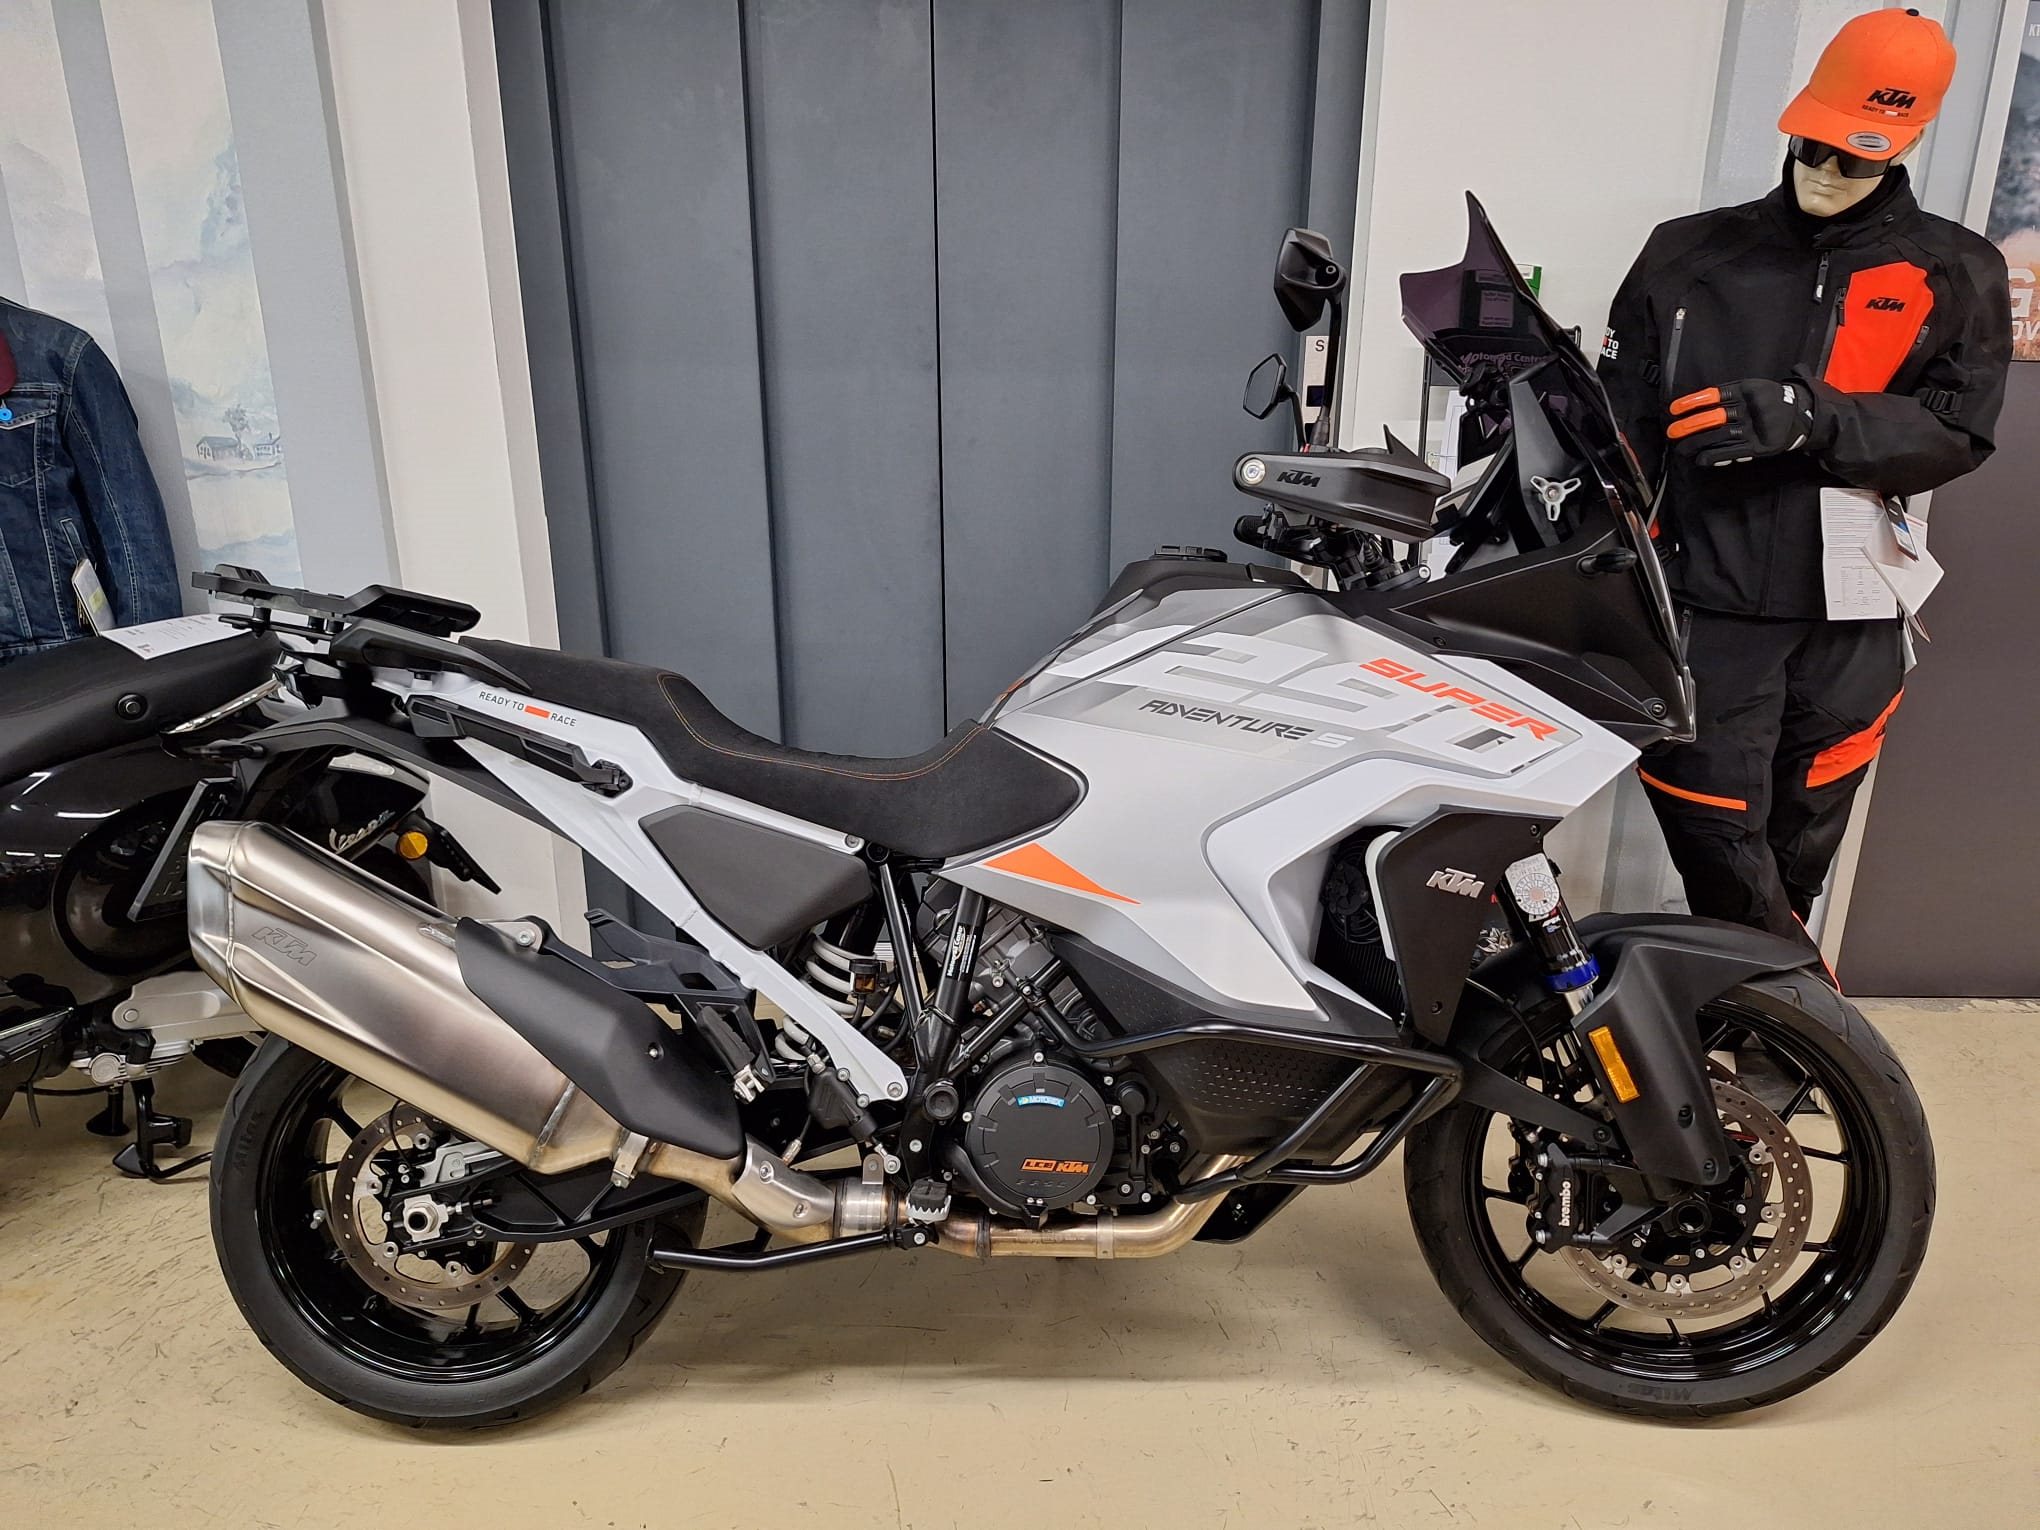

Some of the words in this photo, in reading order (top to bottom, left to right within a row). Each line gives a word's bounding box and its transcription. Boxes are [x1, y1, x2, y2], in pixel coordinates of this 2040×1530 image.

[1866, 87, 1917, 109] KTM
[1864, 296, 1906, 313] KTM
[1601, 347, 1618, 360] ACE
[1608, 338, 1619, 350] TO
[1277, 469, 1321, 488] KTM
[479, 691, 511, 707] READY
[511, 700, 525, 711] TO
[550, 712, 577, 727] RACE
[1359, 658, 1559, 741] SUPER
[1138, 699, 1315, 740] ADVENTURE
[1309, 732, 1355, 749] S
[1426, 867, 1485, 899] KTM
[251, 926, 318, 967] KTM
[1056, 1161, 1089, 1174] KTM
[1558, 1181, 1571, 1227] brembo
